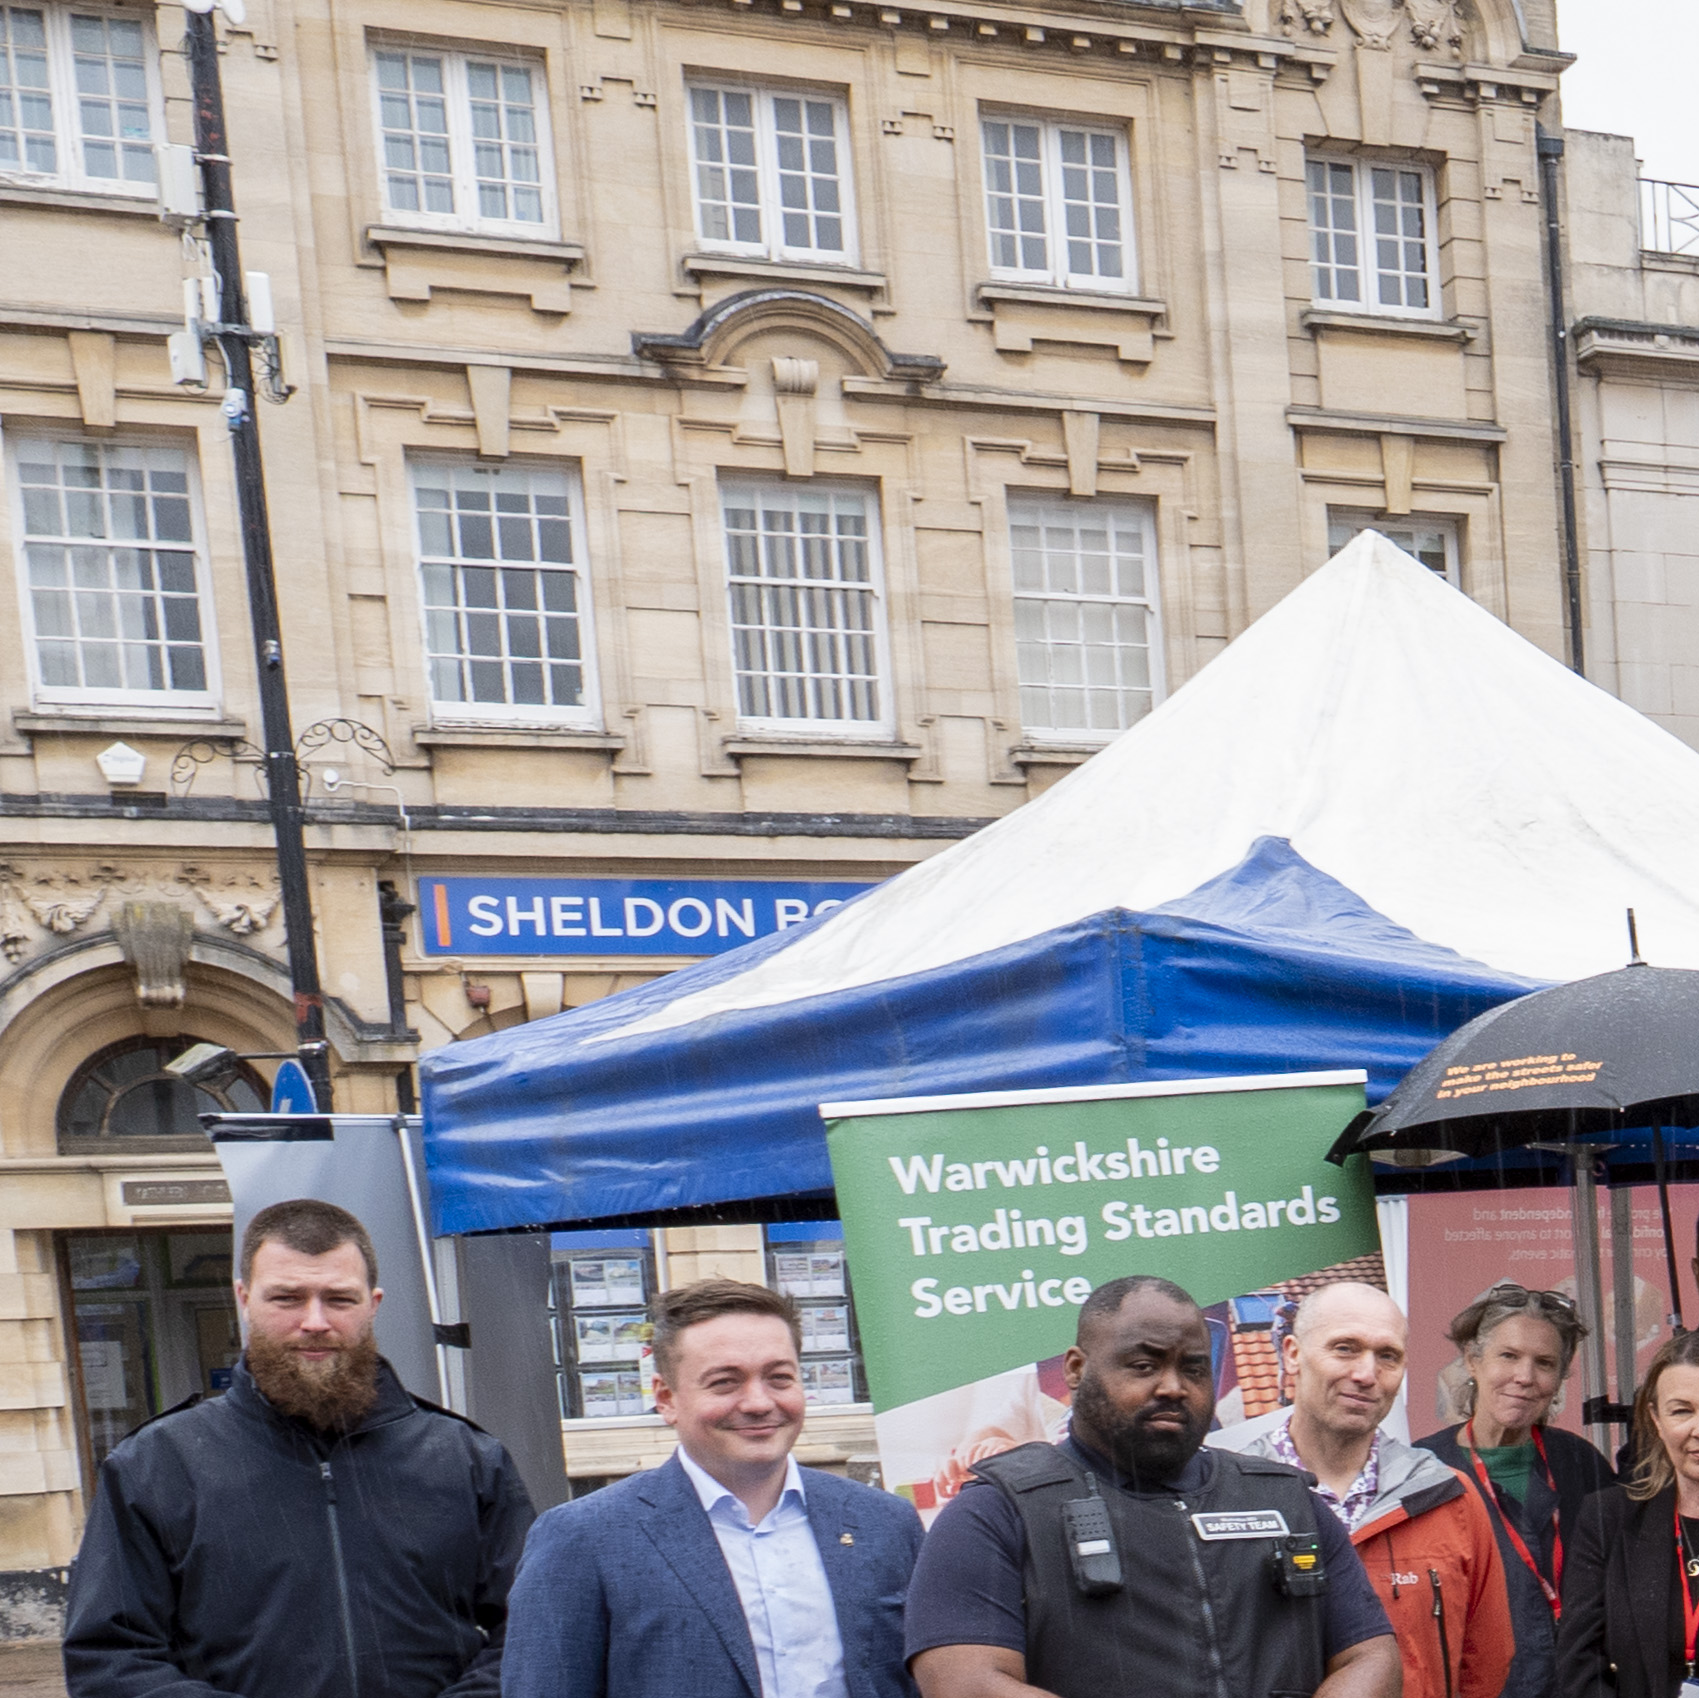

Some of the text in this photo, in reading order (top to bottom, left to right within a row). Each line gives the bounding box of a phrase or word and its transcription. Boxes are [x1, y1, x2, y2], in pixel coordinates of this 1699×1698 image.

[468, 895, 756, 938] SHELDON
[1441, 1061, 1604, 1088] make the streets safer
[1472, 1062, 1498, 1072] are
[1500, 1055, 1559, 1069] working
[1560, 1053, 1577, 1062] to
[1436, 1072, 1597, 1099] in your neighbourhood
[888, 1137, 1221, 1195] Warwickshire
[898, 1185, 1341, 1257] Trading Standards
[911, 1268, 1093, 1319] Service
[1205, 1520, 1280, 1532] SAFETY TEAM
[1391, 1571, 1419, 1586] Rab
